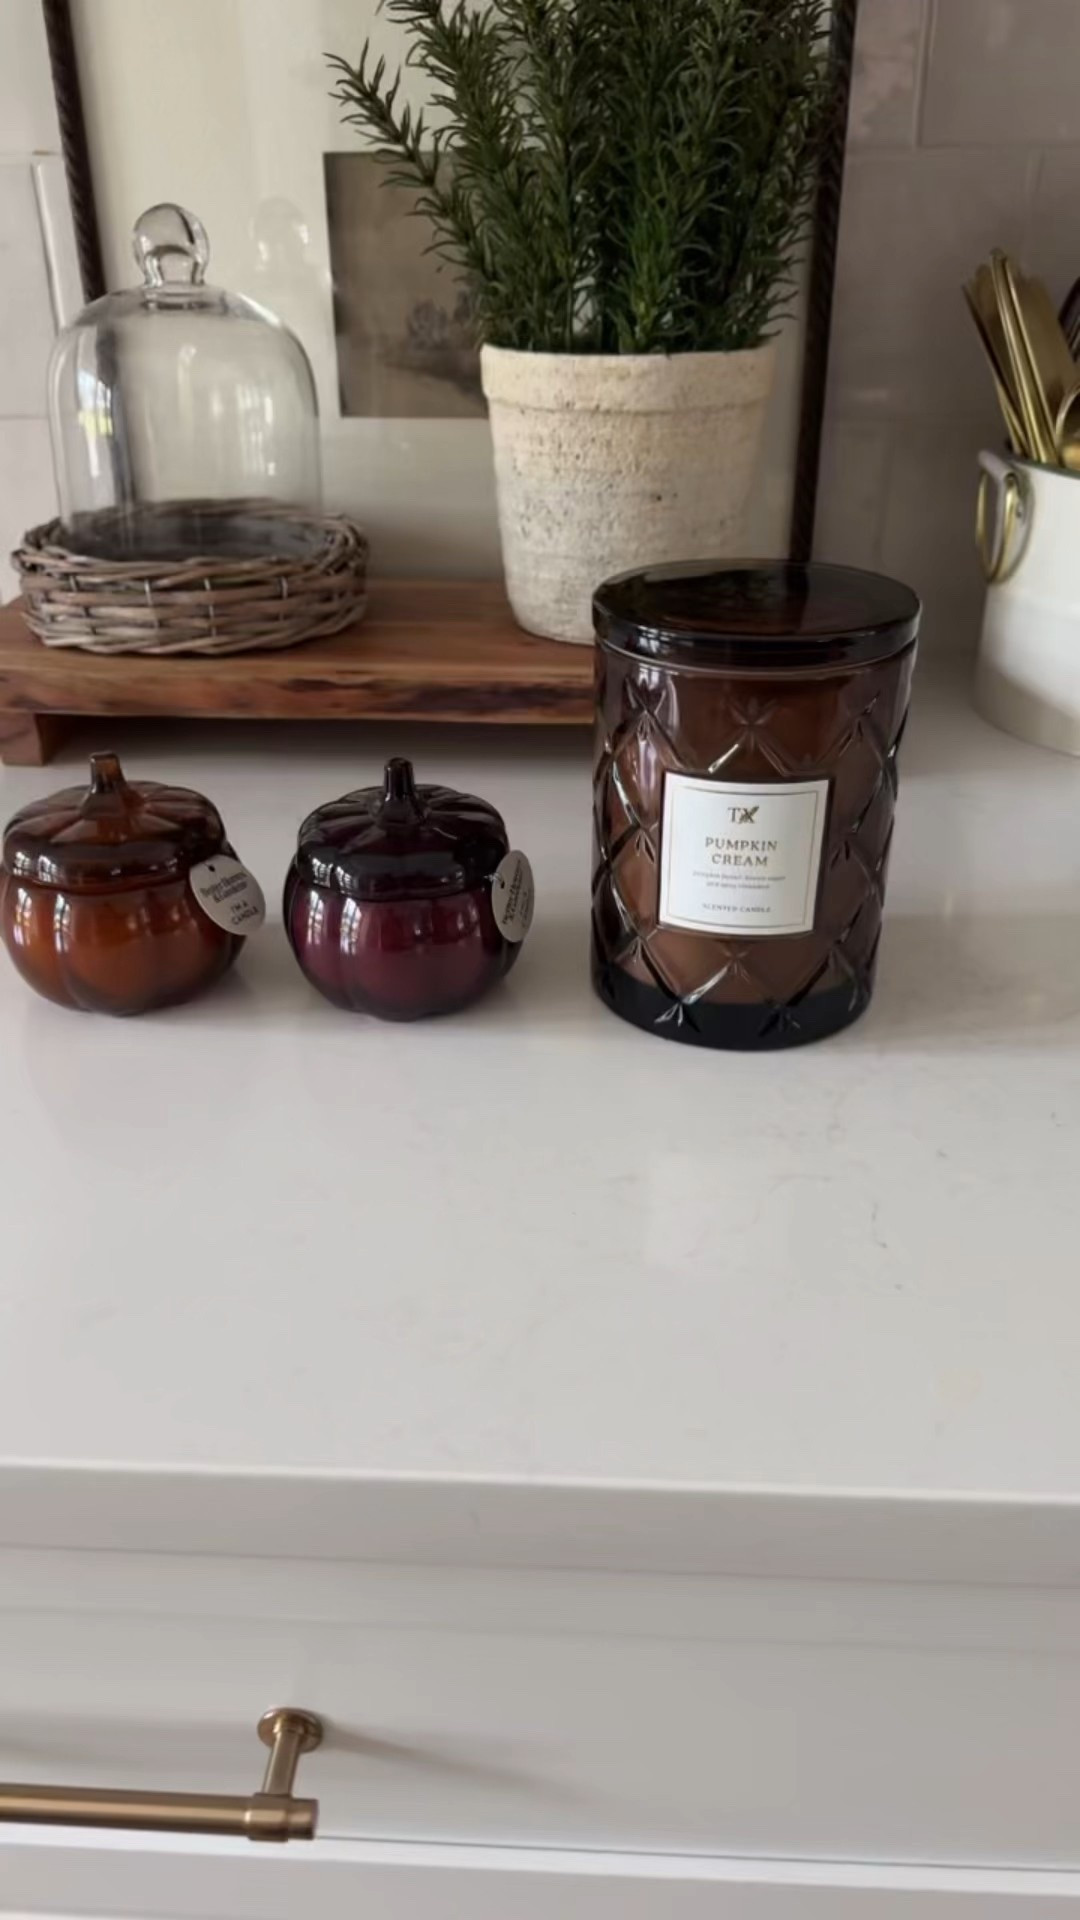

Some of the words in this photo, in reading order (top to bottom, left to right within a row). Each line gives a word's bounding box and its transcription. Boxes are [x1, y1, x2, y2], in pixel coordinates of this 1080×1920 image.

[705, 836, 778, 852] PUMPKIN
[711, 853, 769, 866] CREAM
[739, 904, 772, 913] CANDLE
